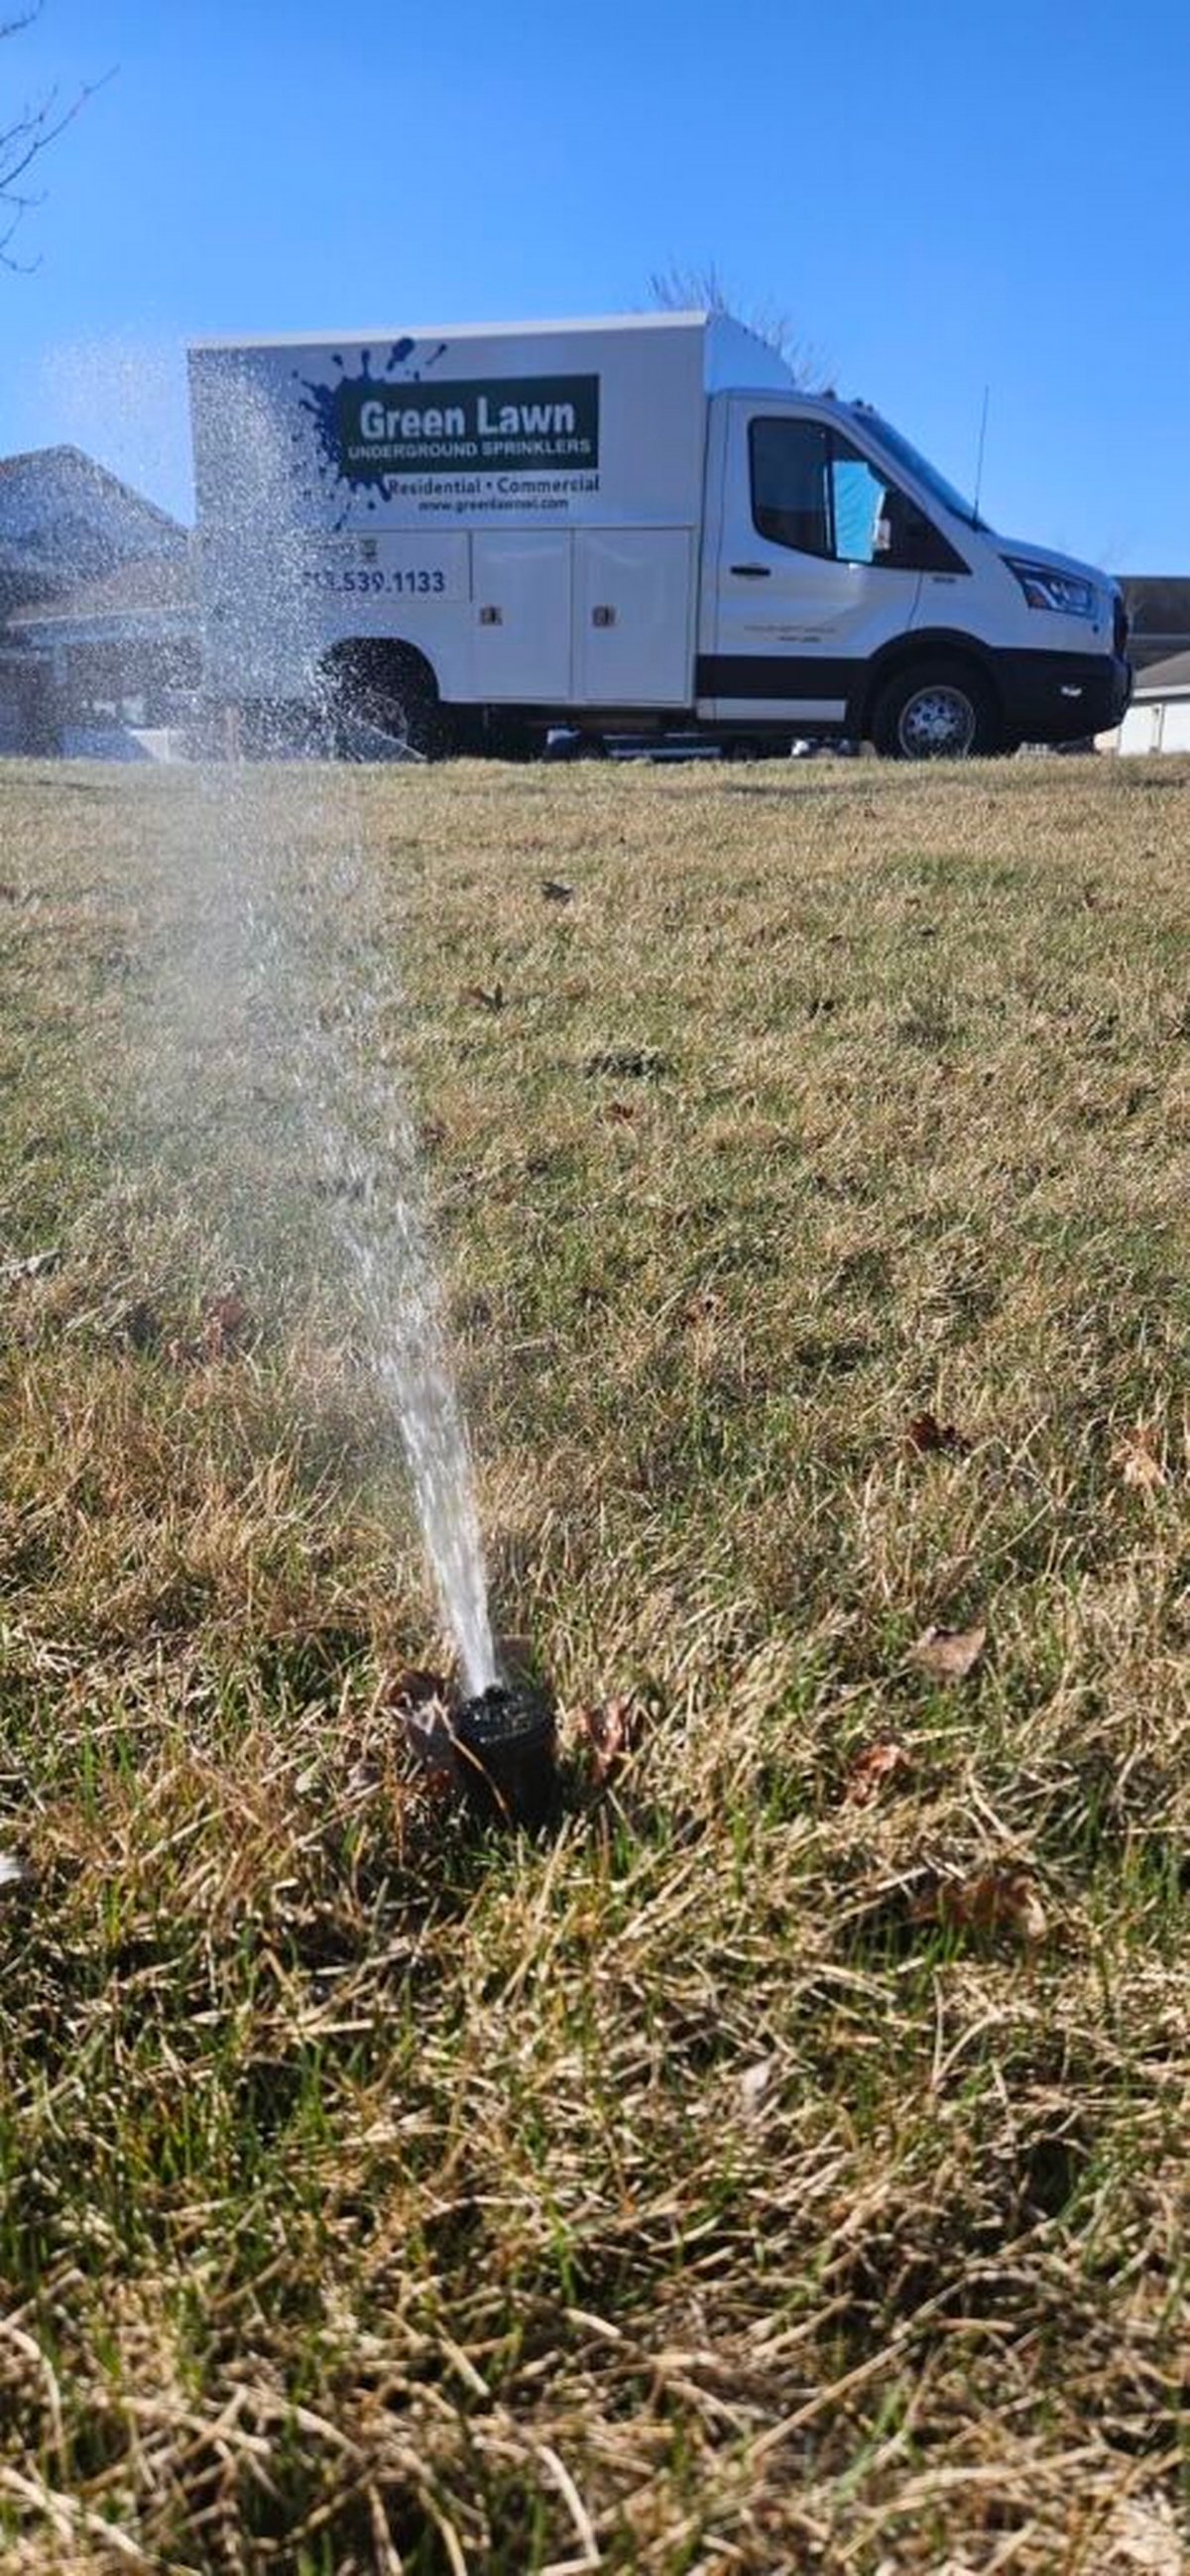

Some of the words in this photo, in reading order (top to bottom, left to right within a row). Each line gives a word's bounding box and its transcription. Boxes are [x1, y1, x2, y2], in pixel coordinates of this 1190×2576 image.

[360, 400, 465, 439] Green
[477, 396, 574, 435] Lawn
[348, 442, 478, 460] UNDERGROUND
[482, 438, 591, 456] SPRINKLERS
[389, 478, 481, 495] Residential
[497, 474, 600, 494] Commercial
[301, 570, 445, 593] .539.1133
